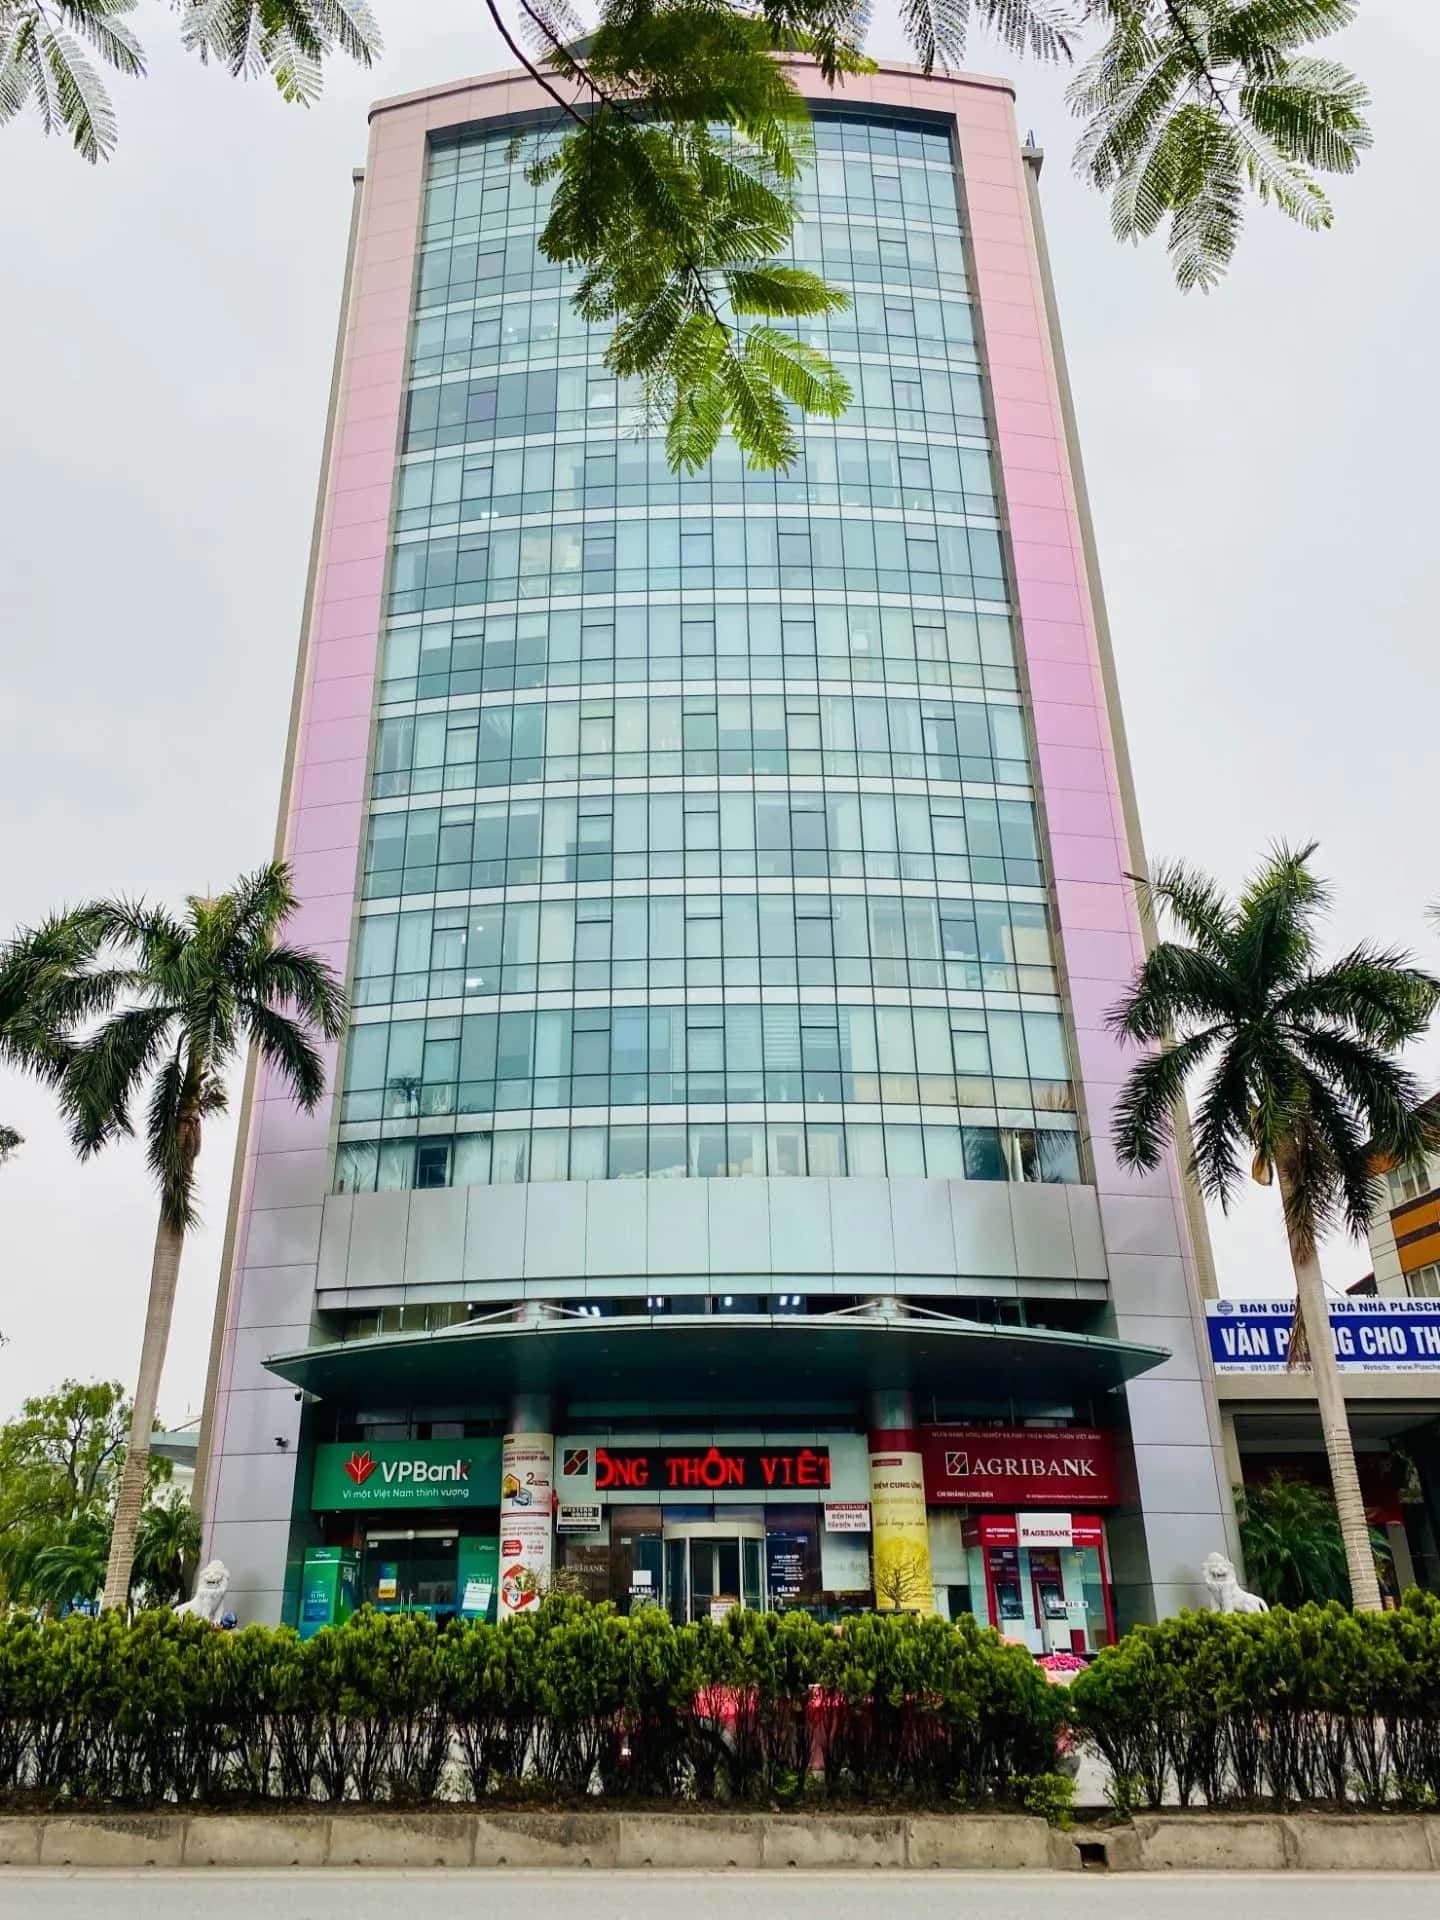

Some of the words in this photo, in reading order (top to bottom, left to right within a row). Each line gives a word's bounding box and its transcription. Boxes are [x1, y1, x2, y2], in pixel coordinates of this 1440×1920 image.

[1239, 1304, 1267, 1313] BAN
[1221, 1321, 1270, 1356] VĂN
[1359, 1326, 1408, 1355] CHO
[381, 1459, 469, 1483] VPBank
[666, 1447, 744, 1487] THÔN
[972, 1458, 1097, 1477] AGRIBANK
[392, 1488, 413, 1497] Nam
[1030, 1529, 1070, 1537] AGRIBANK
